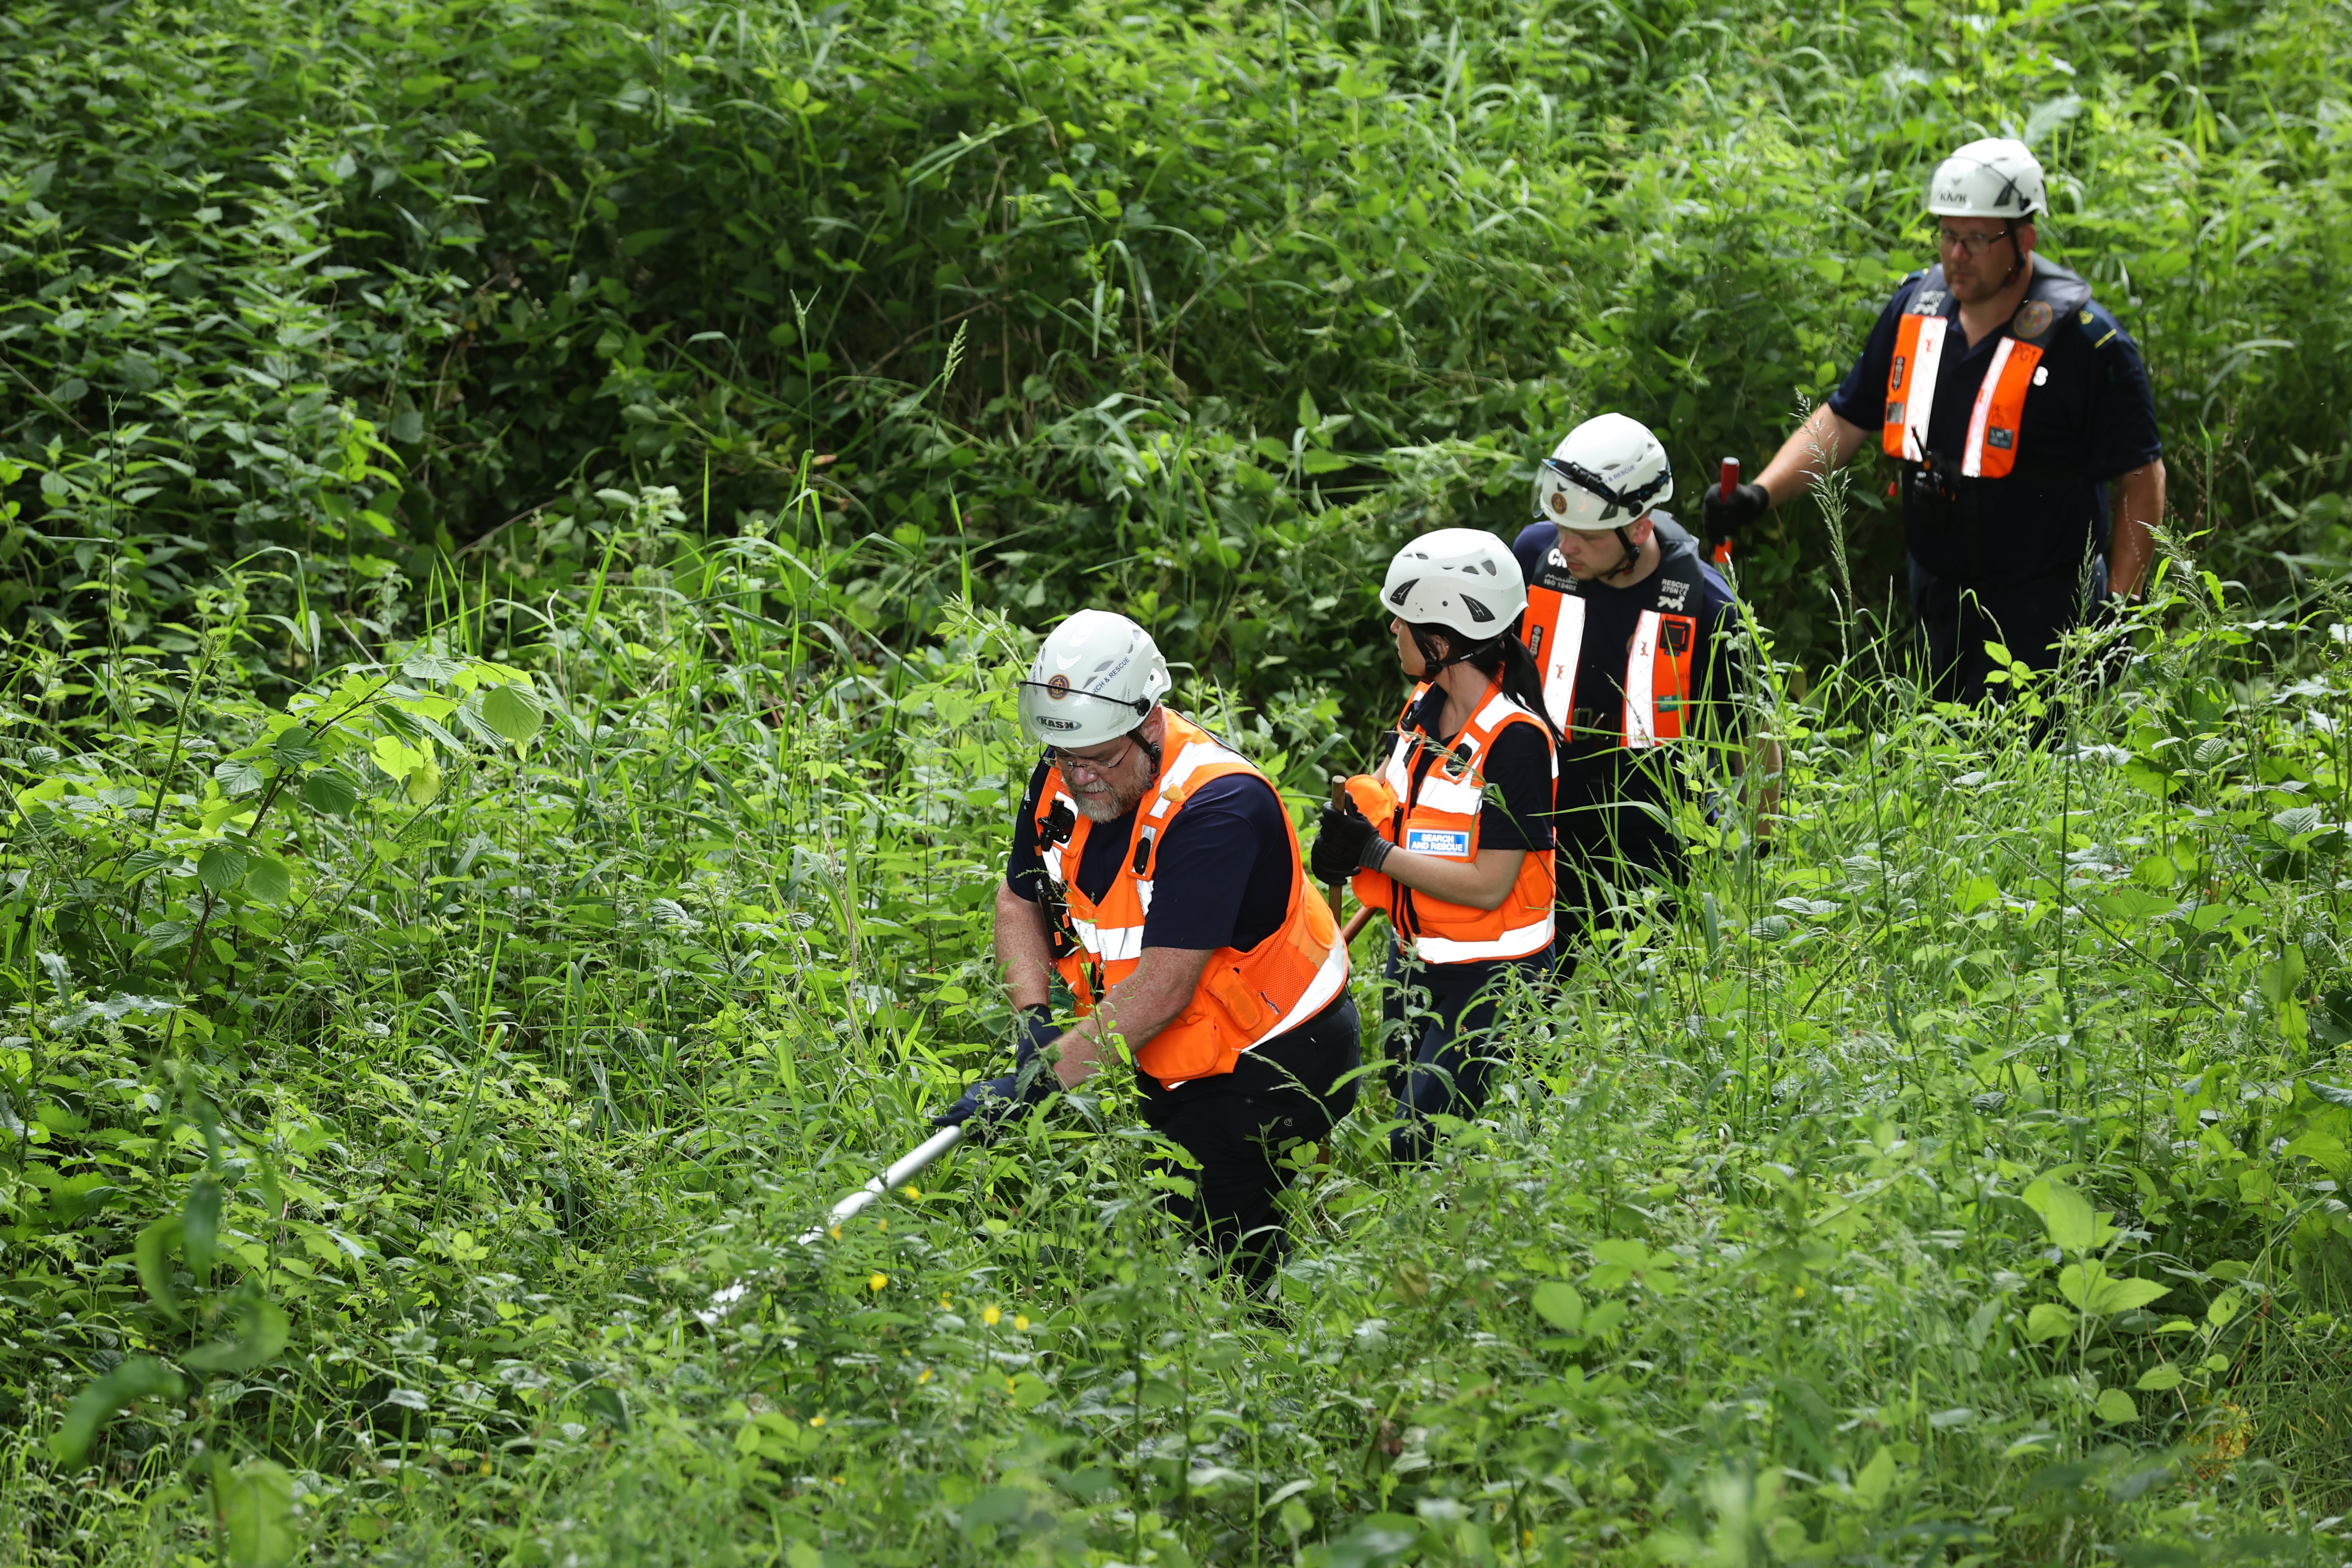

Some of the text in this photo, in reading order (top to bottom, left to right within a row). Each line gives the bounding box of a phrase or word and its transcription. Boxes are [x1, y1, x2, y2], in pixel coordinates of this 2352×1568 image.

[1544, 578, 1556, 586] ISO
[1662, 578, 1690, 591] RESCUE
[1092, 681, 1105, 694] RCH
[1109, 657, 1130, 678] RESCUE
[1040, 717, 1074, 729] KASK
[1421, 834, 1454, 843] SEARCH
[1411, 841, 1463, 851] AND RESCUE
